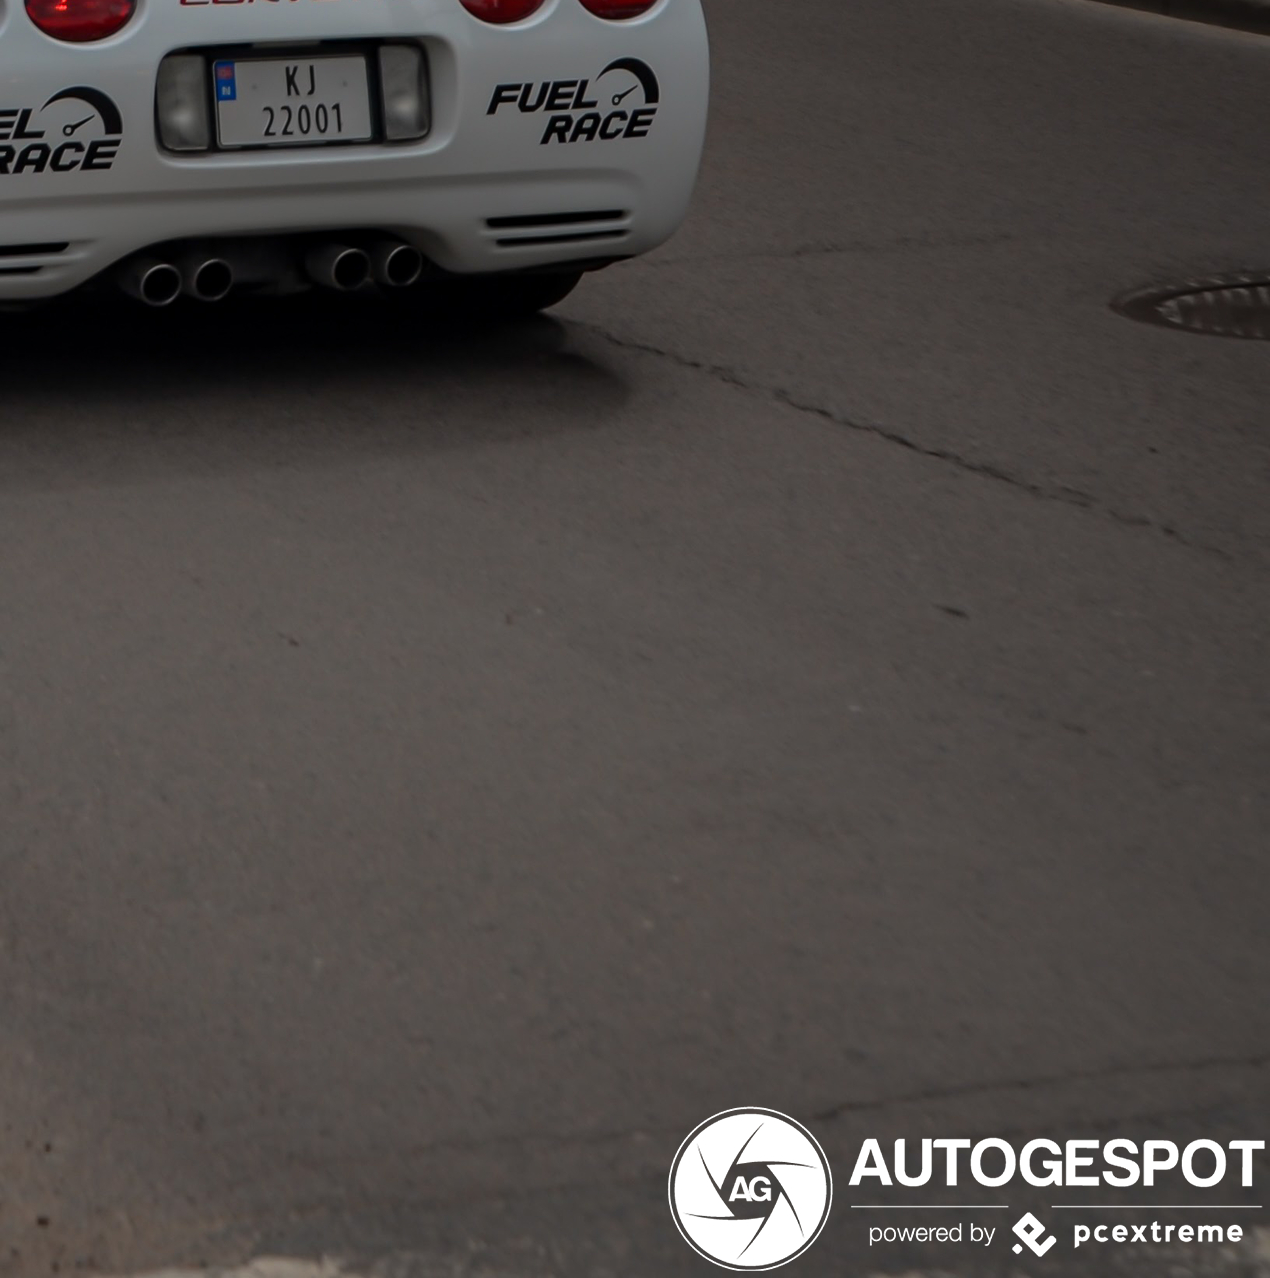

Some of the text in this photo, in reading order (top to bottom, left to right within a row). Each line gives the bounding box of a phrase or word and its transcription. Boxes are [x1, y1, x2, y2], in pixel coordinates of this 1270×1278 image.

[285, 65, 316, 97] KJ
[486, 79, 598, 115] FUEL
[262, 102, 343, 137] 22001
[540, 107, 658, 145] RACE
